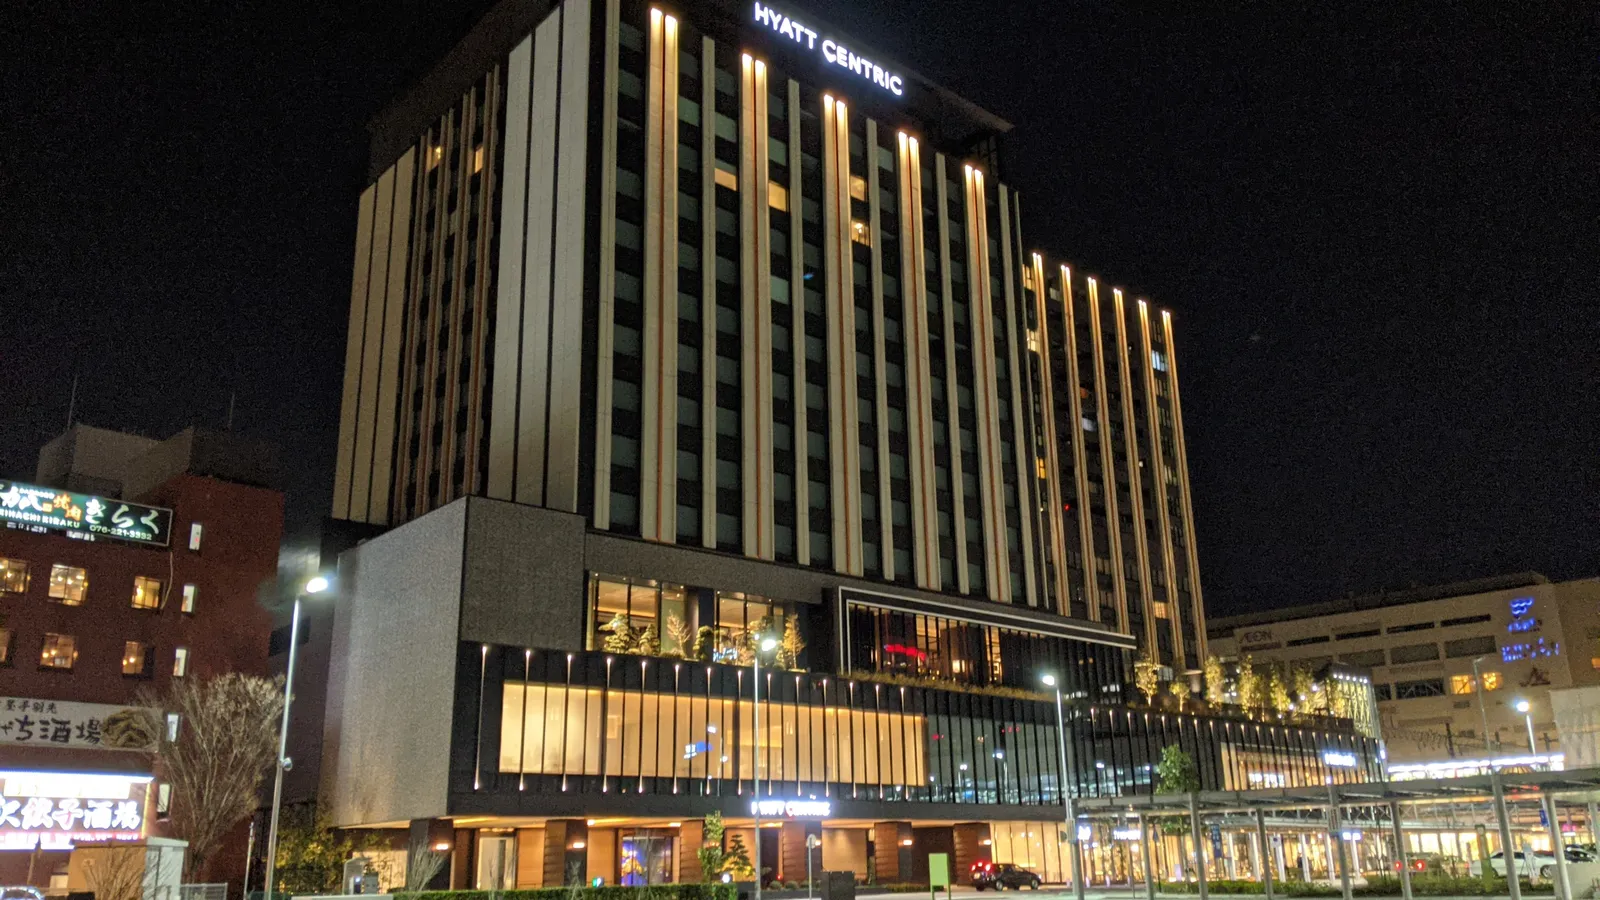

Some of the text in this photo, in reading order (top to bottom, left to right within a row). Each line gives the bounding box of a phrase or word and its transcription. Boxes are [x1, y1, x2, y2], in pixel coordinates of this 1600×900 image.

[754, 1, 903, 96] HYATT CENTRIC
[85, 498, 159, 534] きらく
